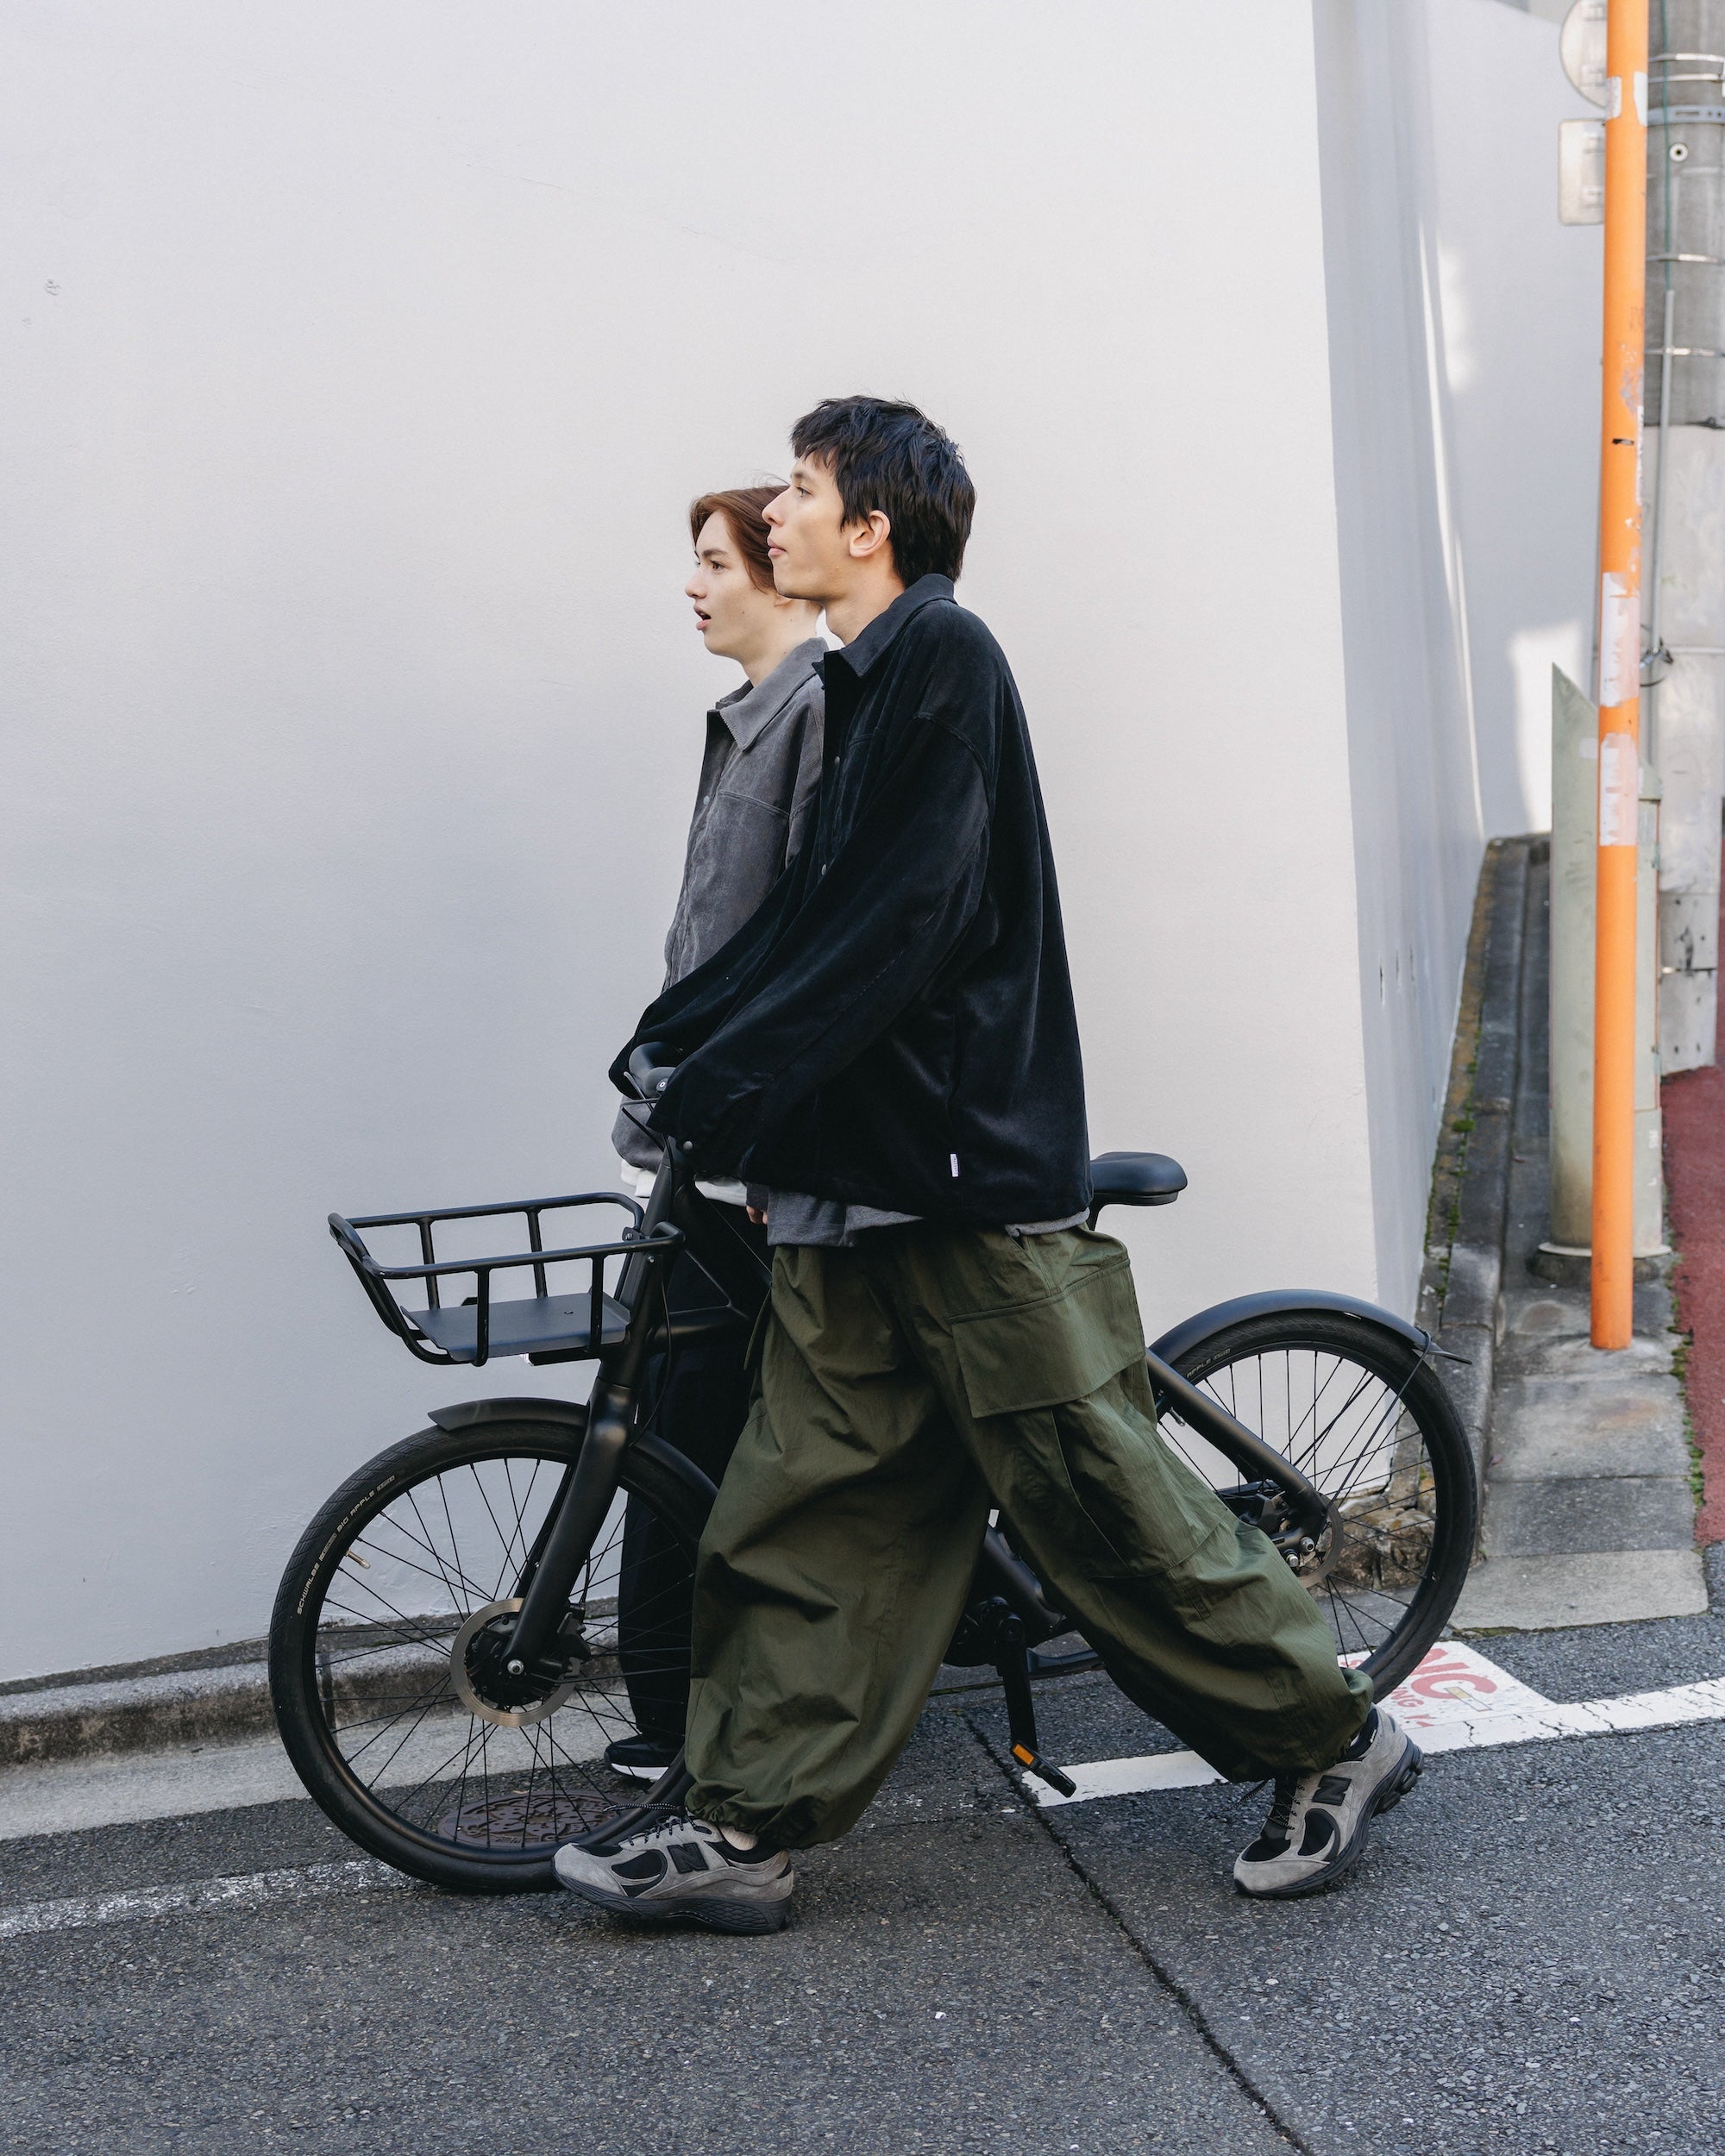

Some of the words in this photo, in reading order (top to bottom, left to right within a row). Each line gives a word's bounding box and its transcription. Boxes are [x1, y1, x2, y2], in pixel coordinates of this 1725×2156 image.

[297, 1562, 320, 1615] SCHWALBE
[336, 1516, 349, 1532] BIG
[349, 1489, 375, 1517] APPLE
[1311, 1774, 1352, 1807] N
[667, 1842, 710, 1874] N
